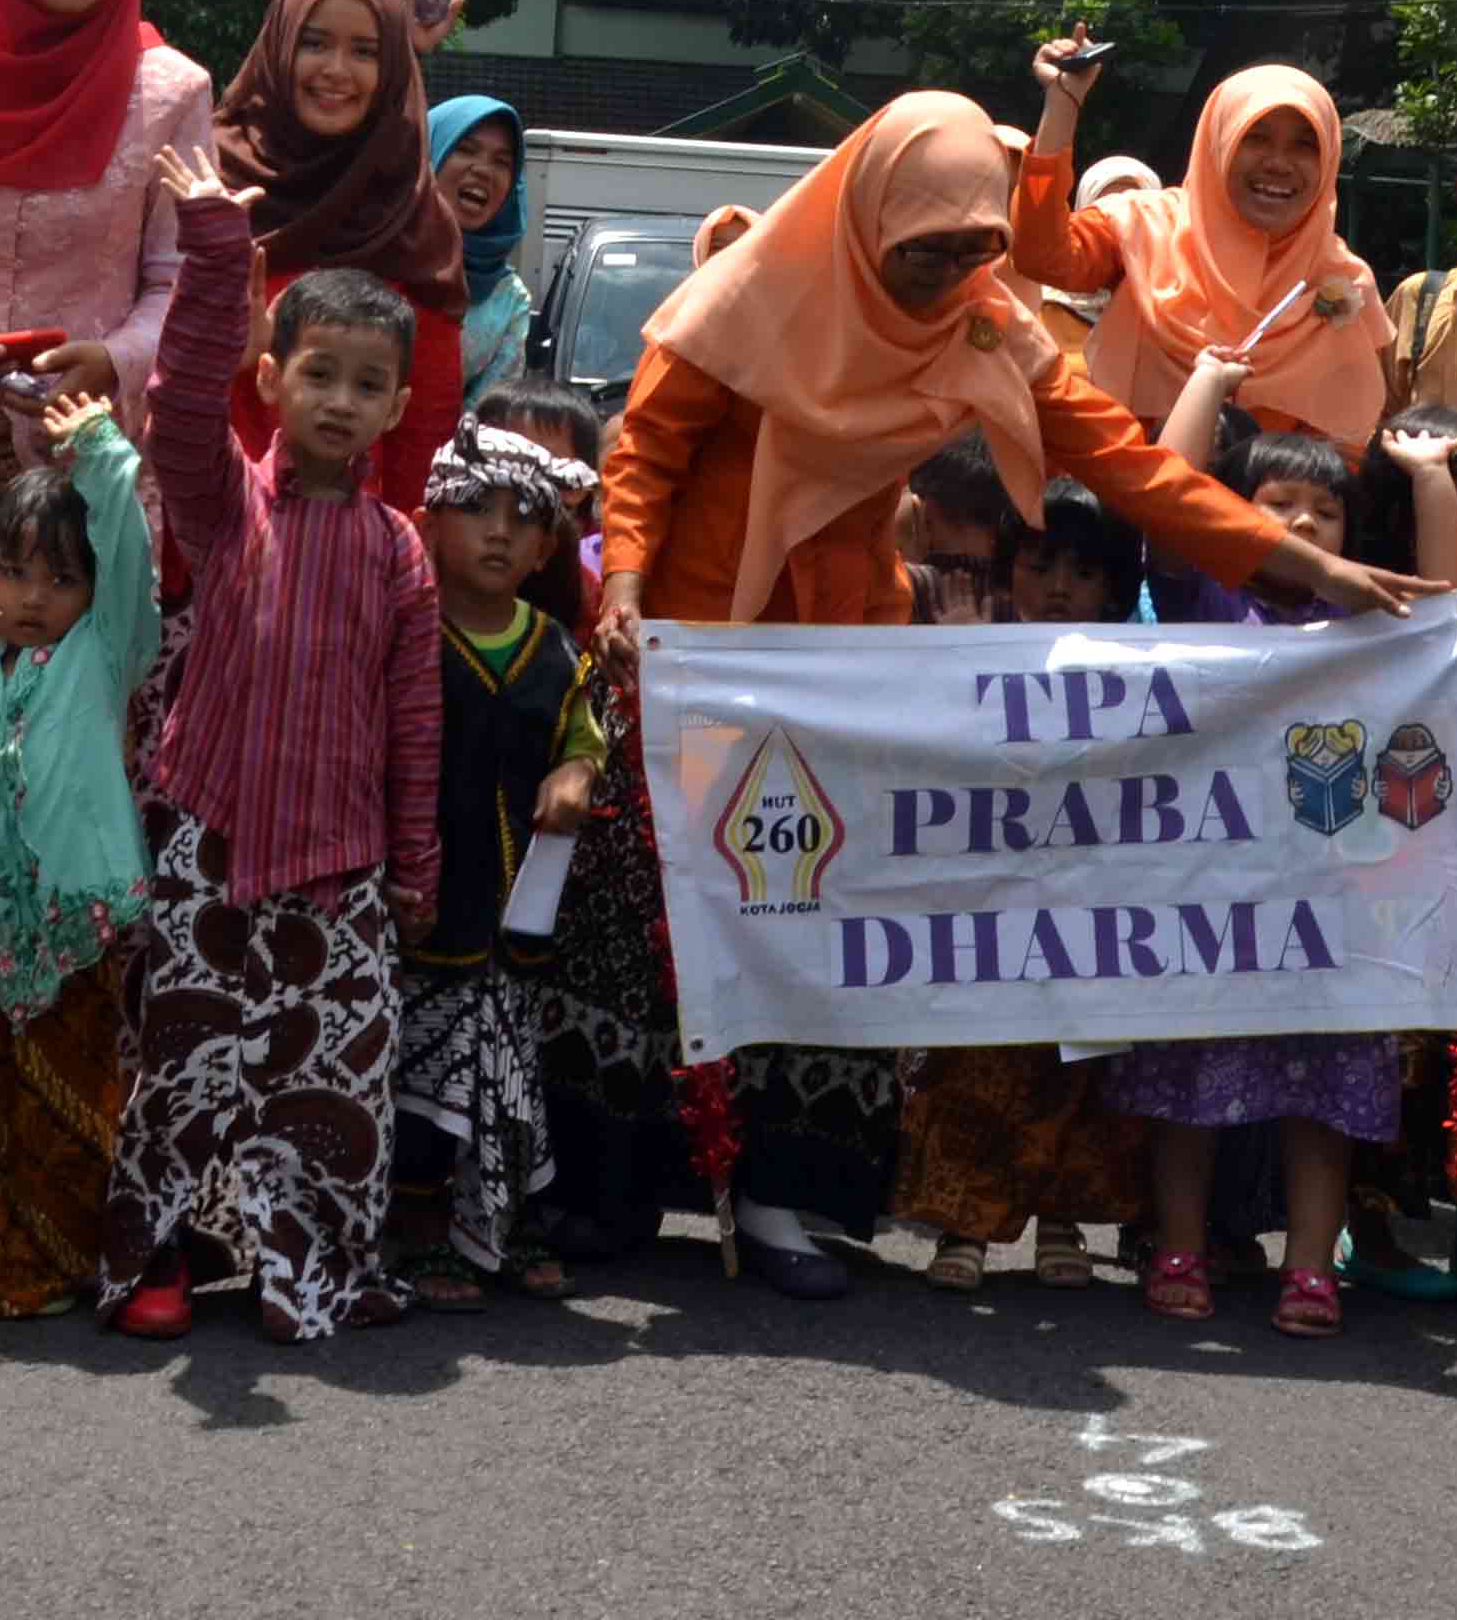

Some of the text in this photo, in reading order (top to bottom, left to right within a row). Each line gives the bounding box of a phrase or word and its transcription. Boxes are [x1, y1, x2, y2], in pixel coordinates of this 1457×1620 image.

[975, 666, 1196, 744] TPA
[761, 795, 796, 809] HUT
[882, 770, 1258, 857] PRABA
[742, 813, 822, 853] 260
[740, 904, 776, 916] KOTA
[834, 898, 1343, 989] DHARMA
